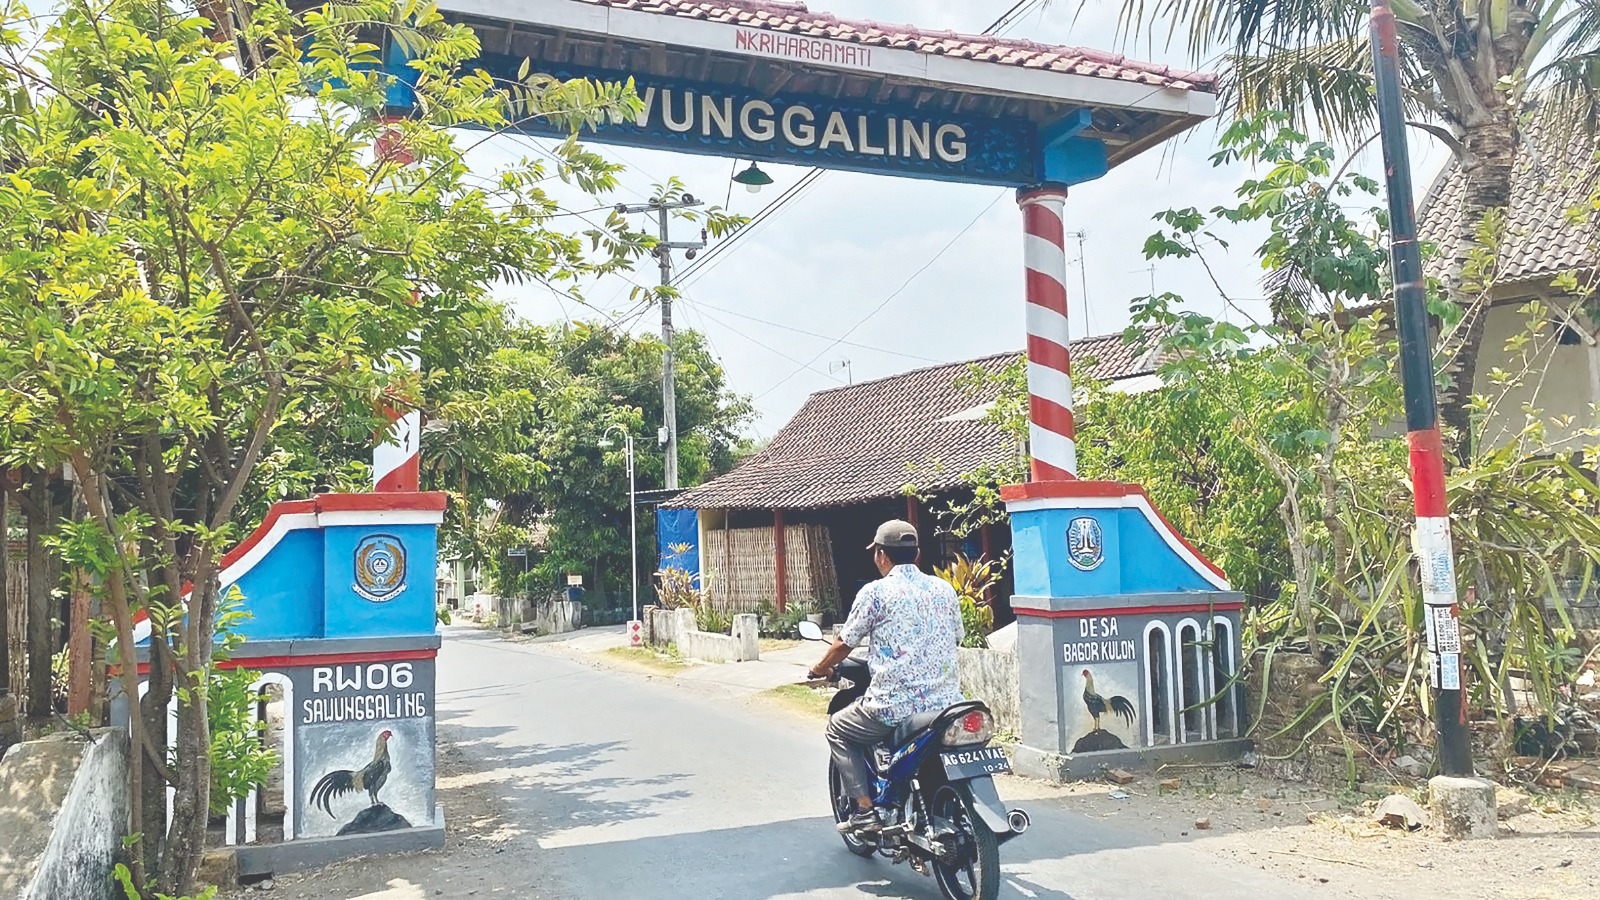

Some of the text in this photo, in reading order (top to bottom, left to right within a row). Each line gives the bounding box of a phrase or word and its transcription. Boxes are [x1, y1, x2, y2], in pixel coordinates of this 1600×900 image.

[1063, 639, 1136, 663] BAGOR KULON
[943, 747, 1006, 767] AG 6241 VAE
